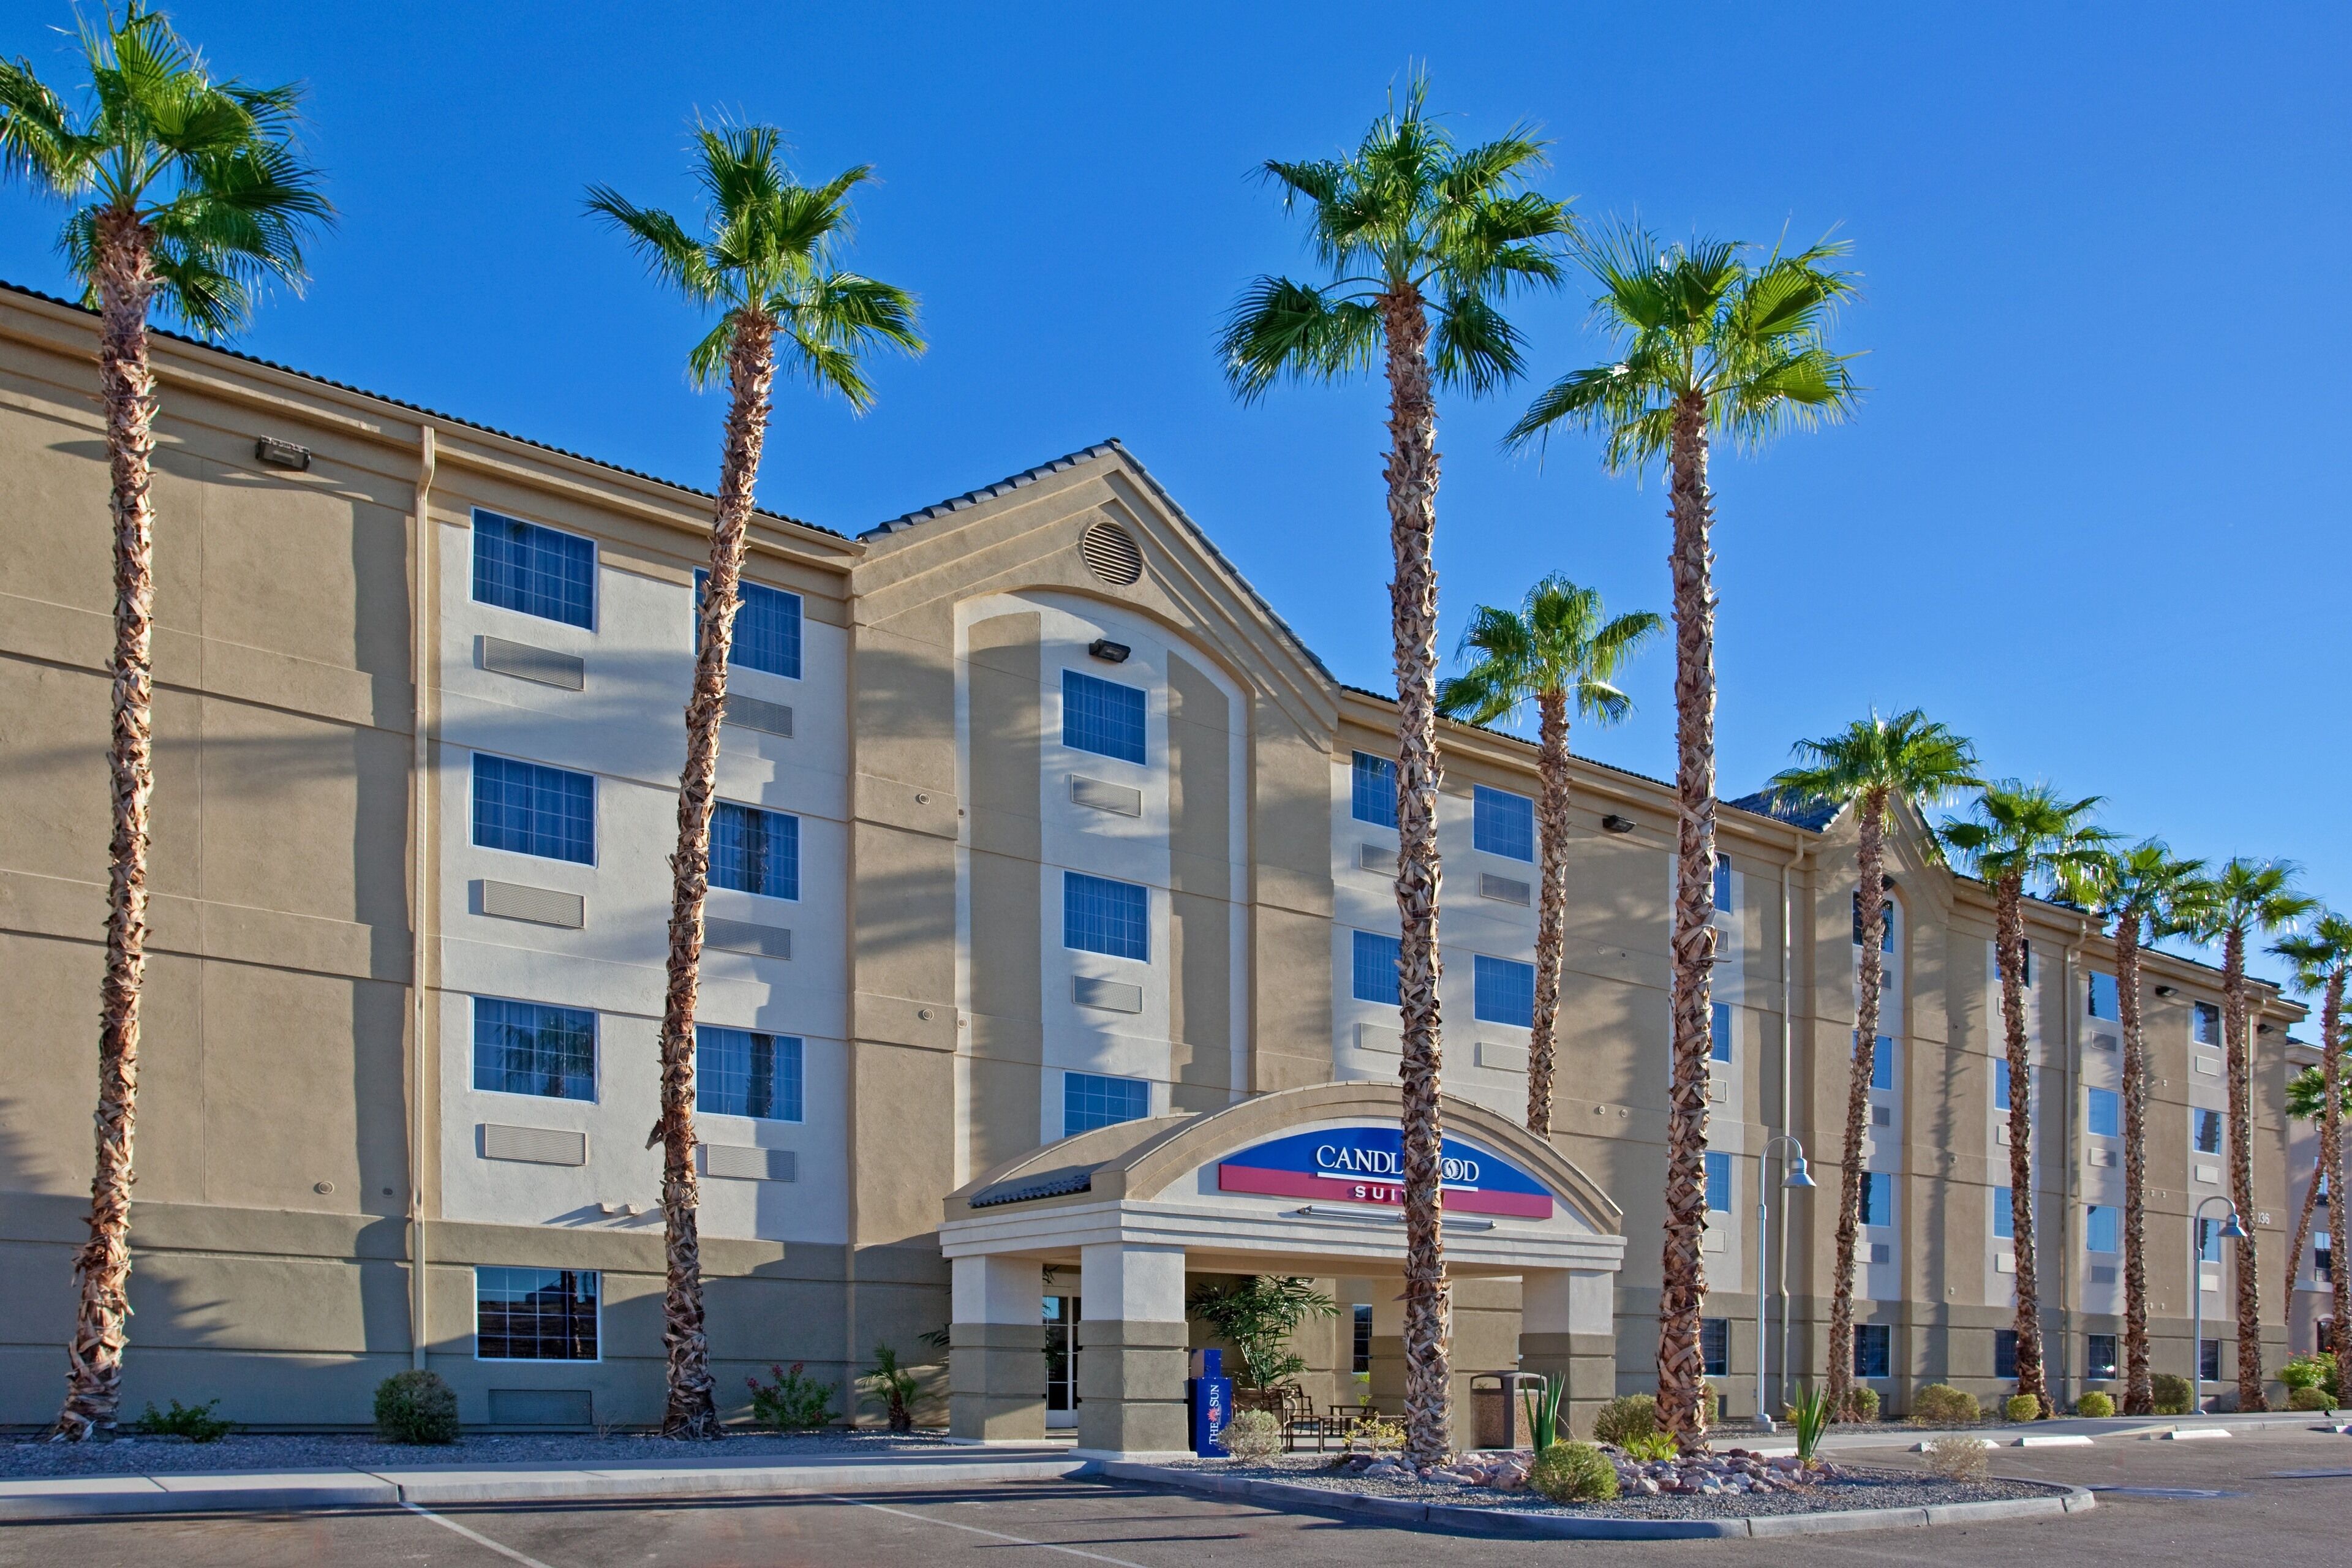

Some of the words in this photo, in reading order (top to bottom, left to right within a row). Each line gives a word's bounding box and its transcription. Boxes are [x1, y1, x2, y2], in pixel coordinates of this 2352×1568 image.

[1316, 1145, 1479, 1182] CANDLOOD
[1209, 1384, 1219, 1407] SUN
[1208, 1422, 1219, 1445] THE
